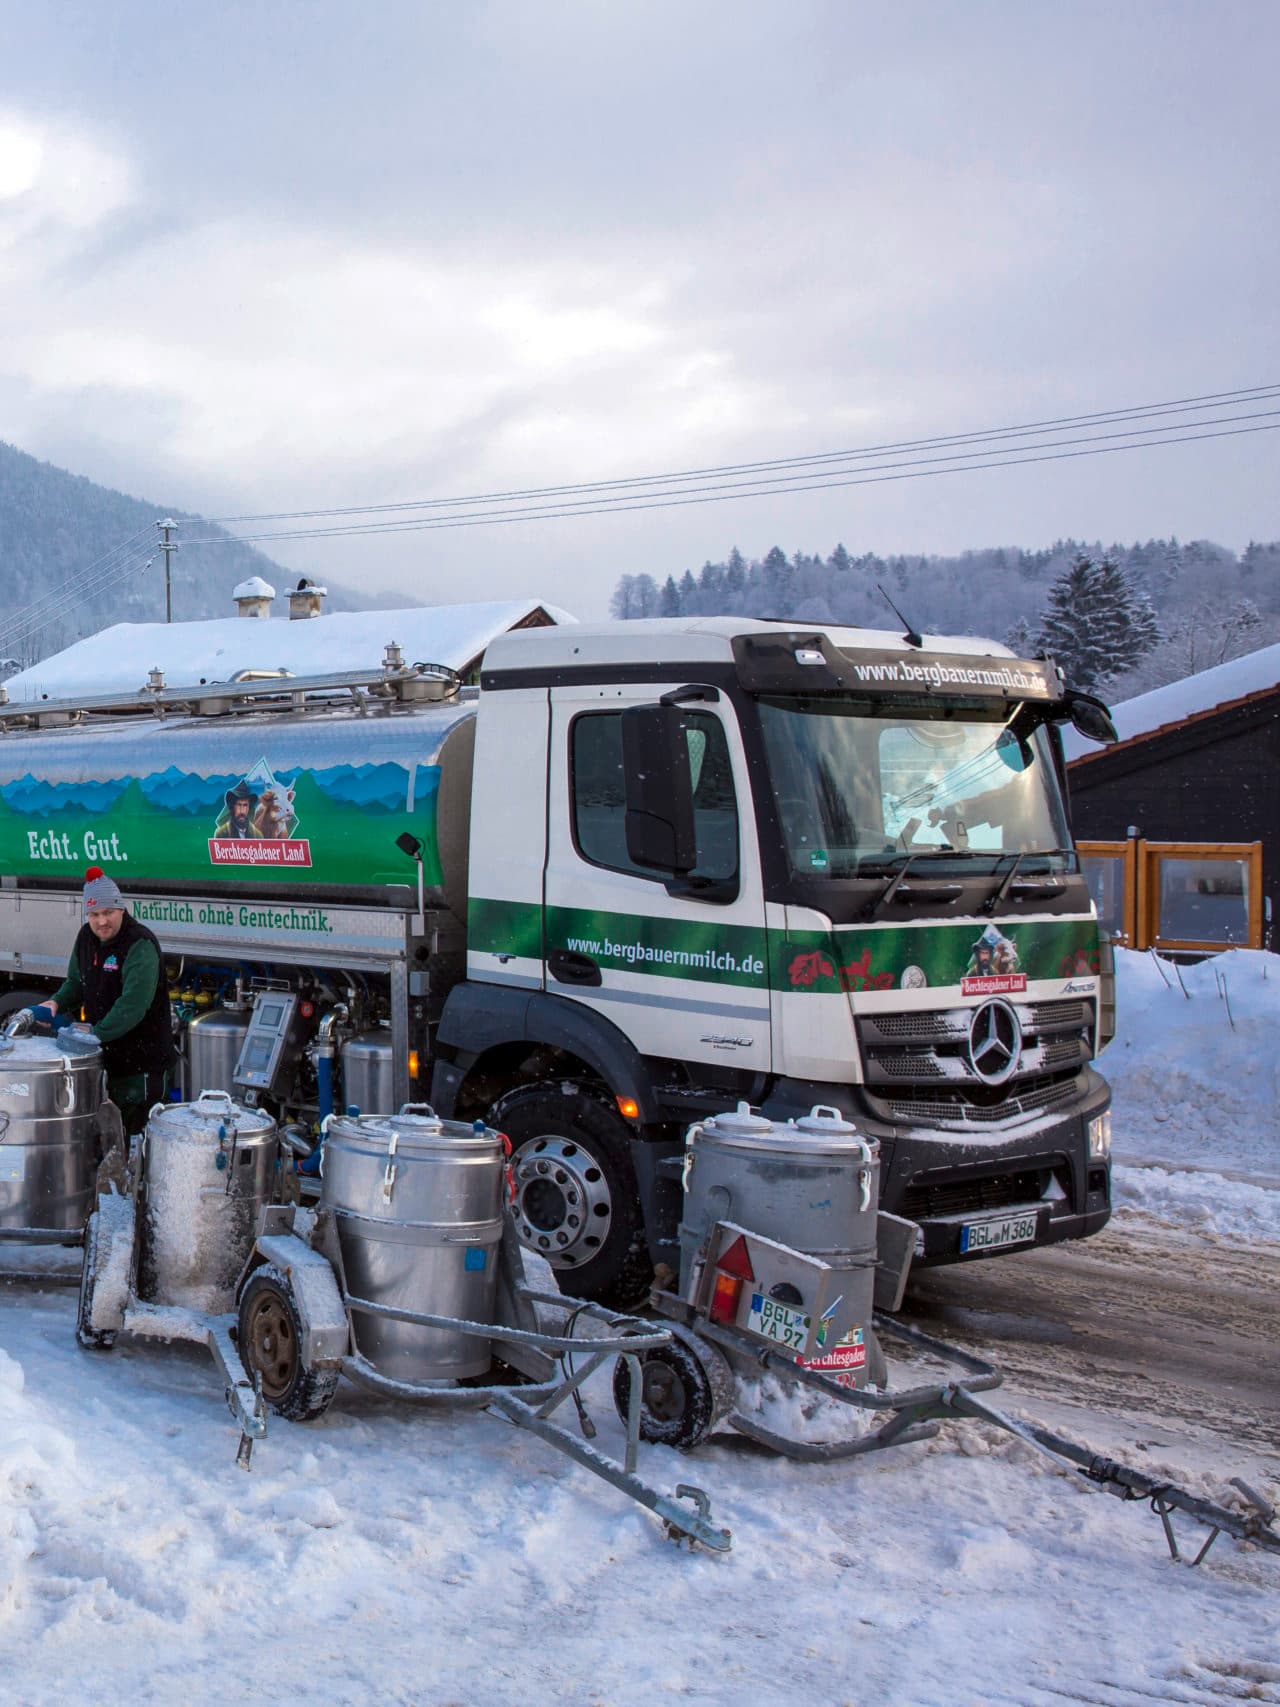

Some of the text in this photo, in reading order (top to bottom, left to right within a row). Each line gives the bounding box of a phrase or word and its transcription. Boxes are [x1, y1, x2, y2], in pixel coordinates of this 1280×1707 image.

[854, 661, 1047, 691] www.bergbauernmilch.de
[27, 830, 128, 861] Echt. Gut.
[214, 842, 305, 863] Berchtesgadener Land
[133, 901, 333, 932] Natürlich ohne Gentechnik.
[567, 937, 764, 974] www.bergbauernmilch.de
[1010, 976, 1024, 989] Land
[969, 1226, 992, 1248] BGL
[760, 1316, 777, 1339] YA
[763, 1301, 793, 1328] BGL
